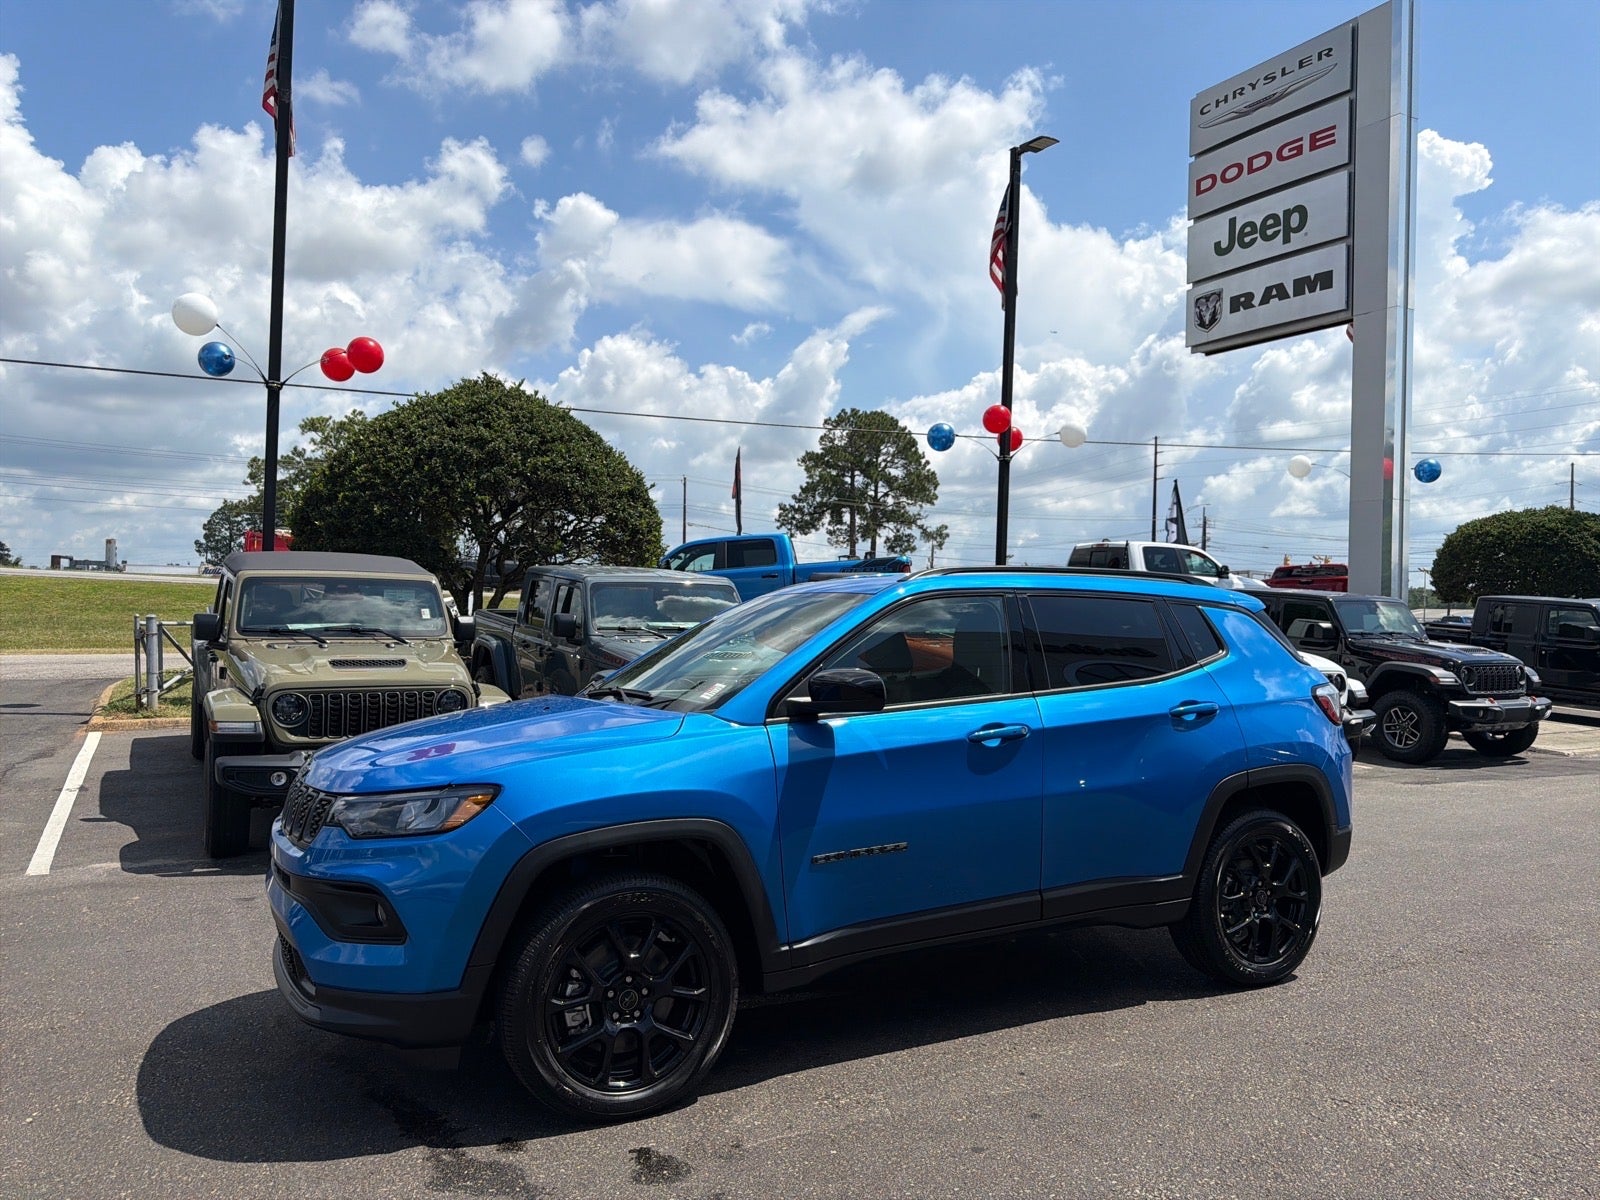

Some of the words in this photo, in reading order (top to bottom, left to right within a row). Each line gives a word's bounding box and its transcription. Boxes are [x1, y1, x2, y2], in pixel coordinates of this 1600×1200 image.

[1199, 47, 1334, 116] CHRYSLER
[1195, 124, 1337, 197] DODGE
[1213, 203, 1308, 257] Jeep
[1229, 269, 1334, 314] RAM
